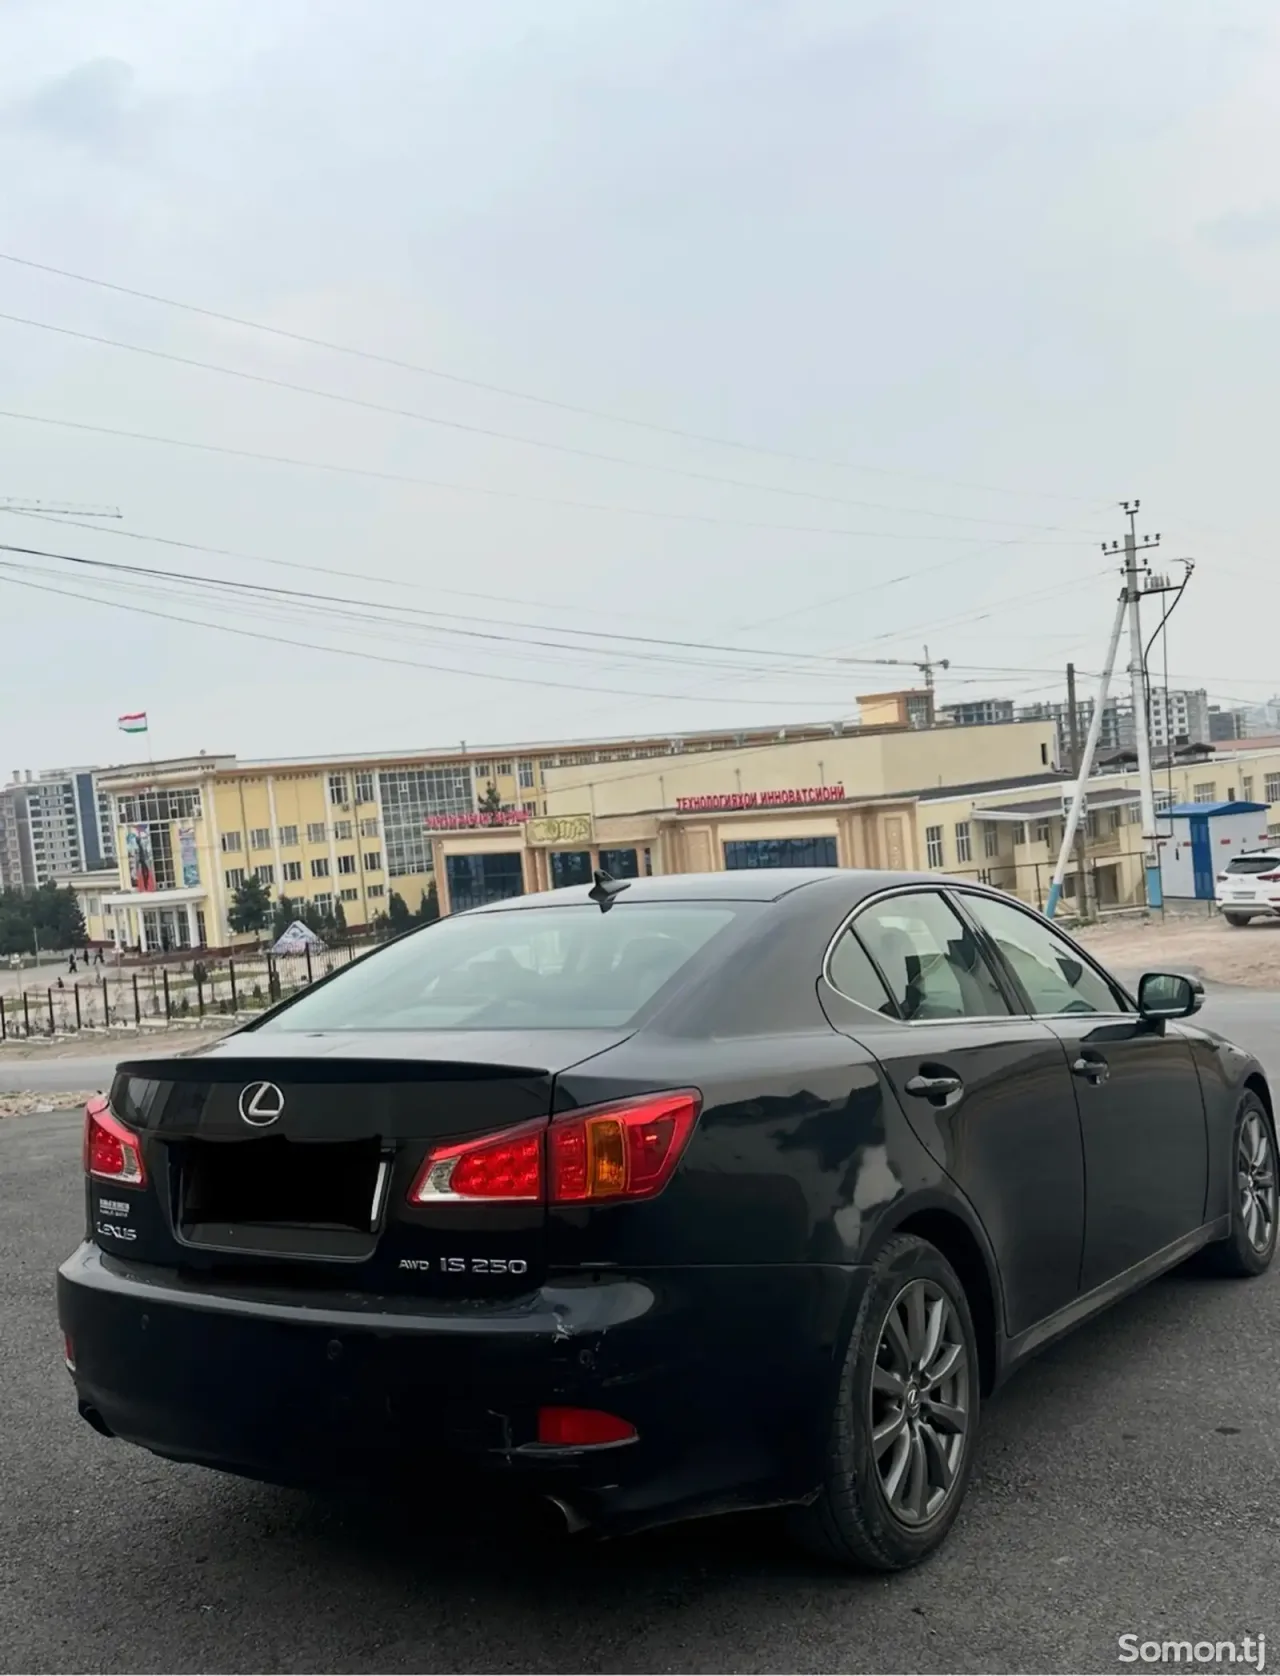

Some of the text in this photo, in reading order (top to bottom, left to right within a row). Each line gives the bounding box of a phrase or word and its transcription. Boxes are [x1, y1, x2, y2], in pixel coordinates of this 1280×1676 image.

[97, 1221, 137, 1241] LEXUS
[399, 1257, 528, 1274] AWD IS 250
